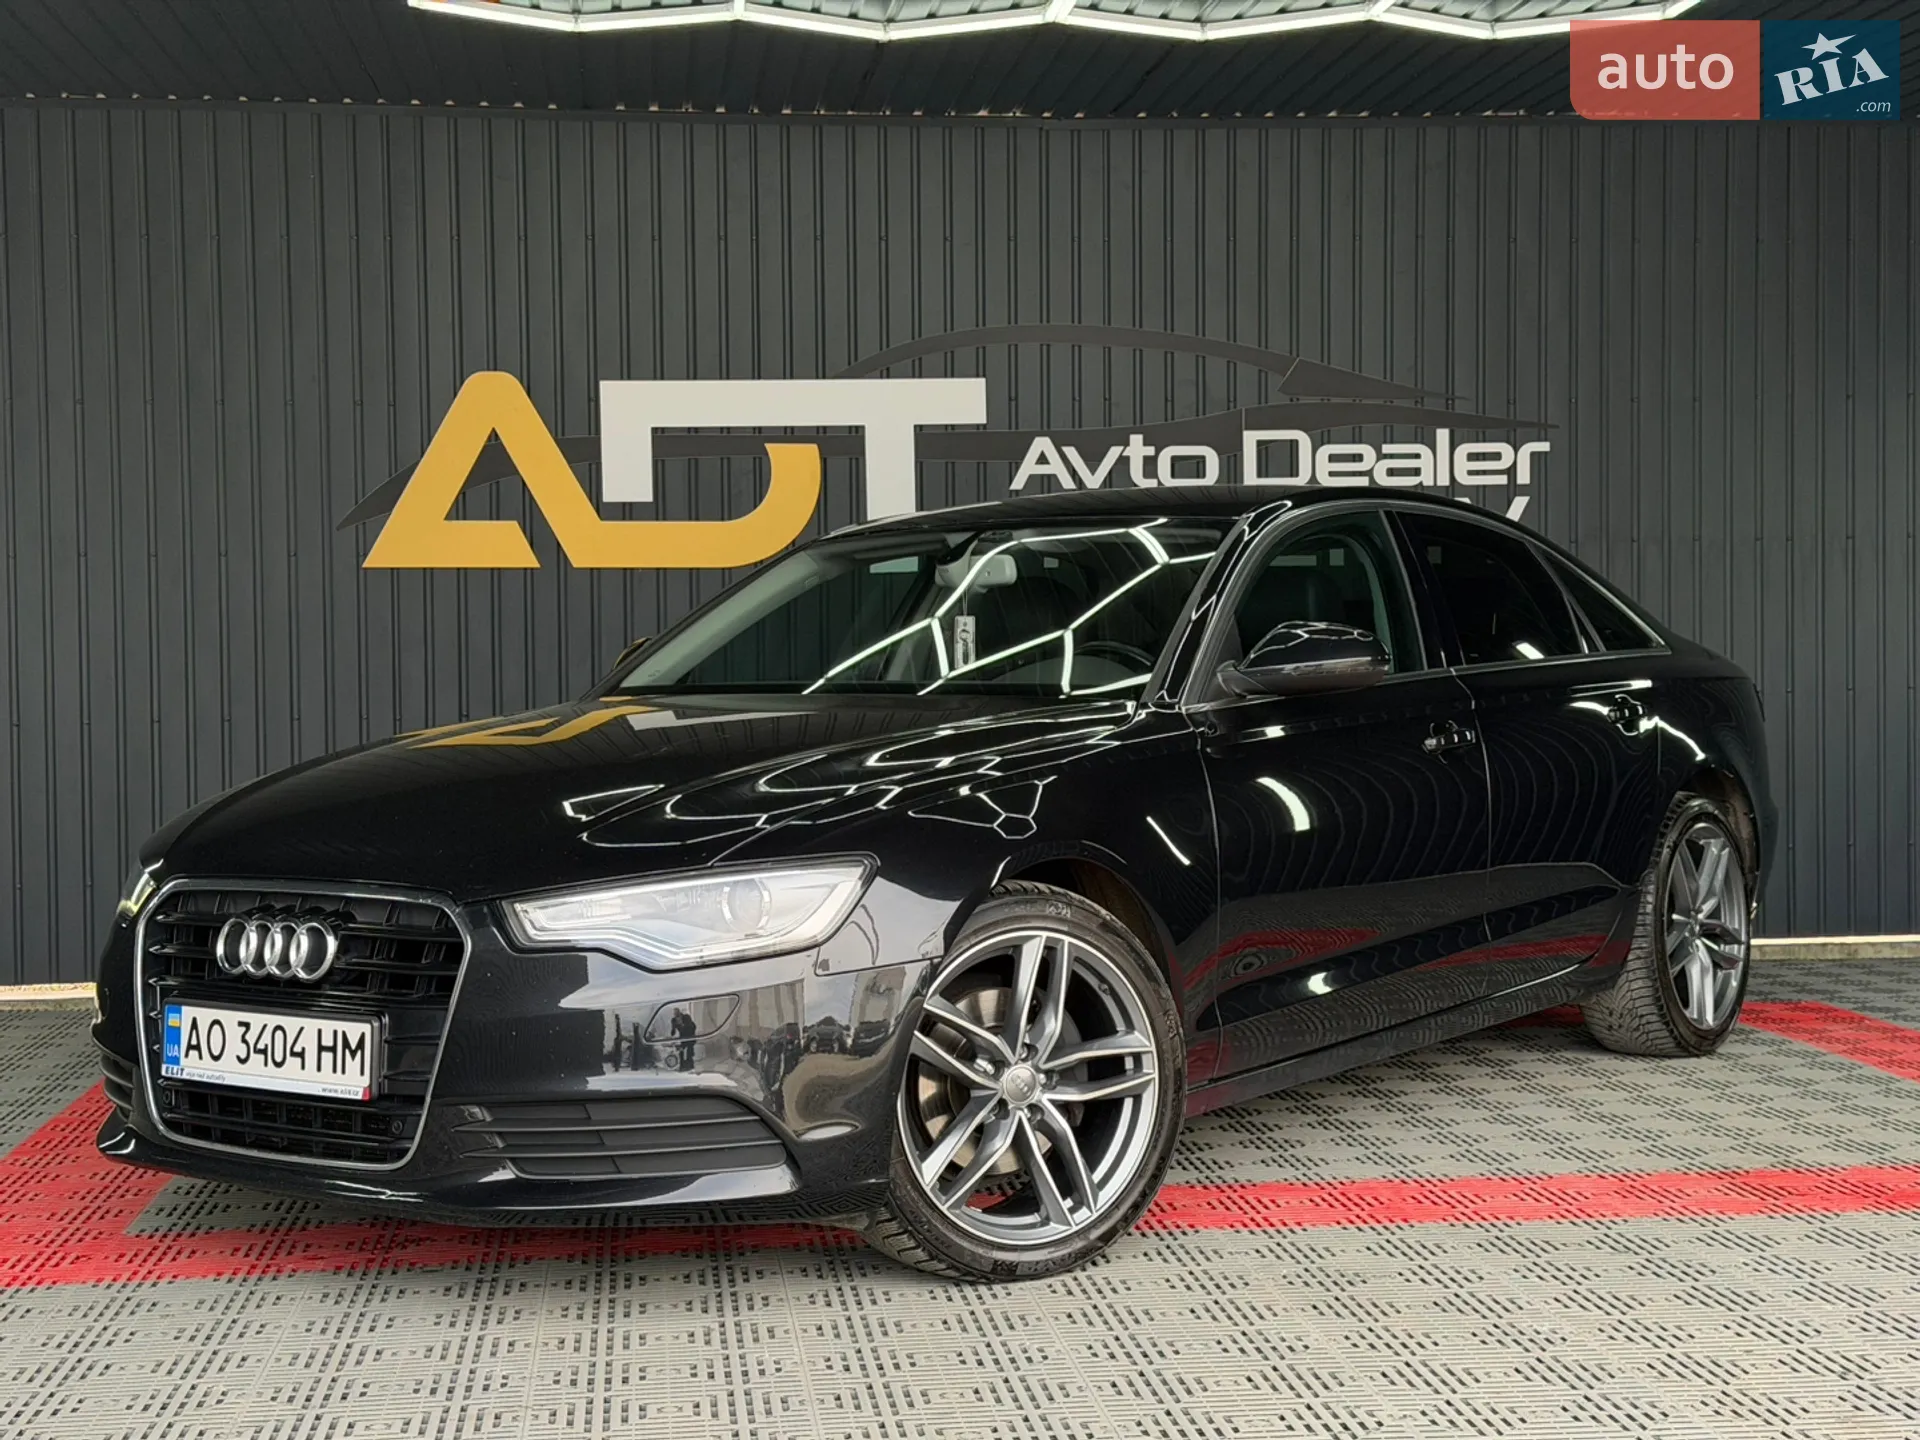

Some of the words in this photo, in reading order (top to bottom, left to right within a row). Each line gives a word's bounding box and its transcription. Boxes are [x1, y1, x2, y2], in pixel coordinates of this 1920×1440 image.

[1009, 434, 1220, 490] Avto
[1243, 428, 1551, 487] Dealer
[166, 1043, 180, 1058] UA
[184, 1016, 227, 1063] AO
[235, 1020, 306, 1071] 3404
[316, 1028, 366, 1077] HM
